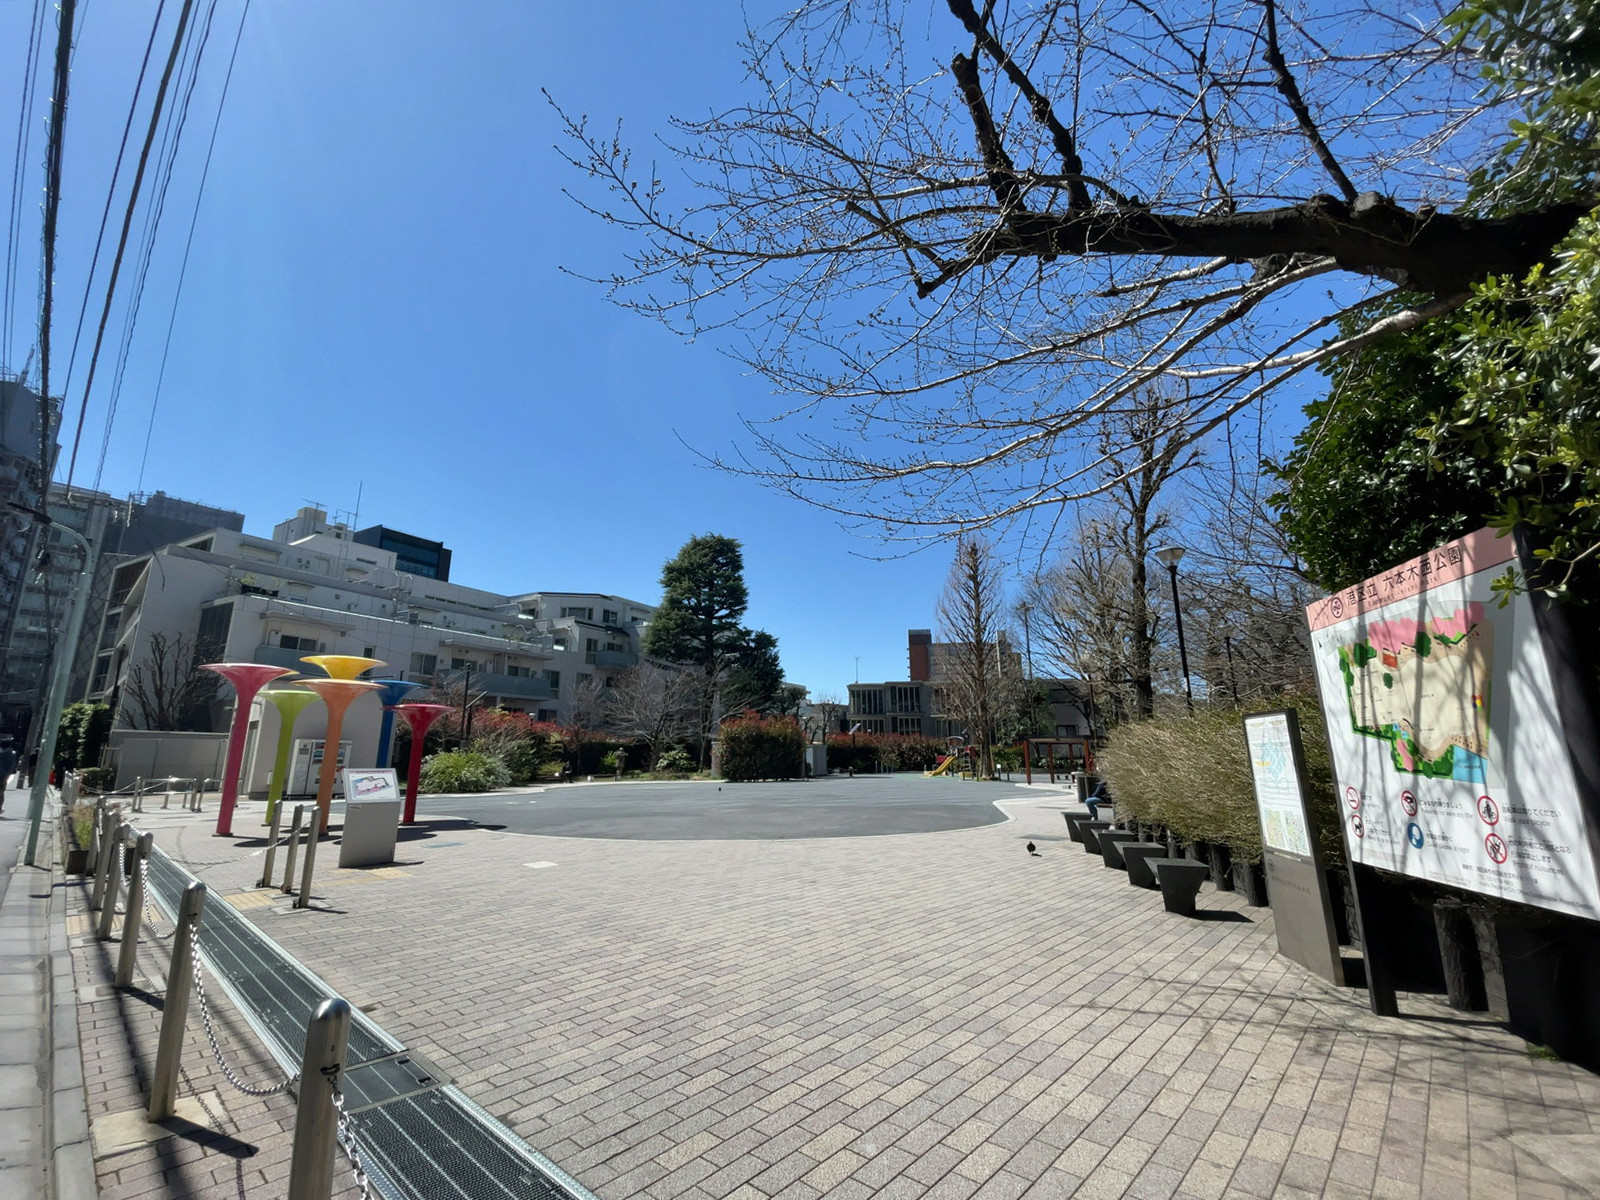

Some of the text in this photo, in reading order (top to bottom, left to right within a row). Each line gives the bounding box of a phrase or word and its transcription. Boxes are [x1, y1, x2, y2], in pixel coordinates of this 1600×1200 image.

[1346, 545, 1462, 606] 港区立 六本木西公園
